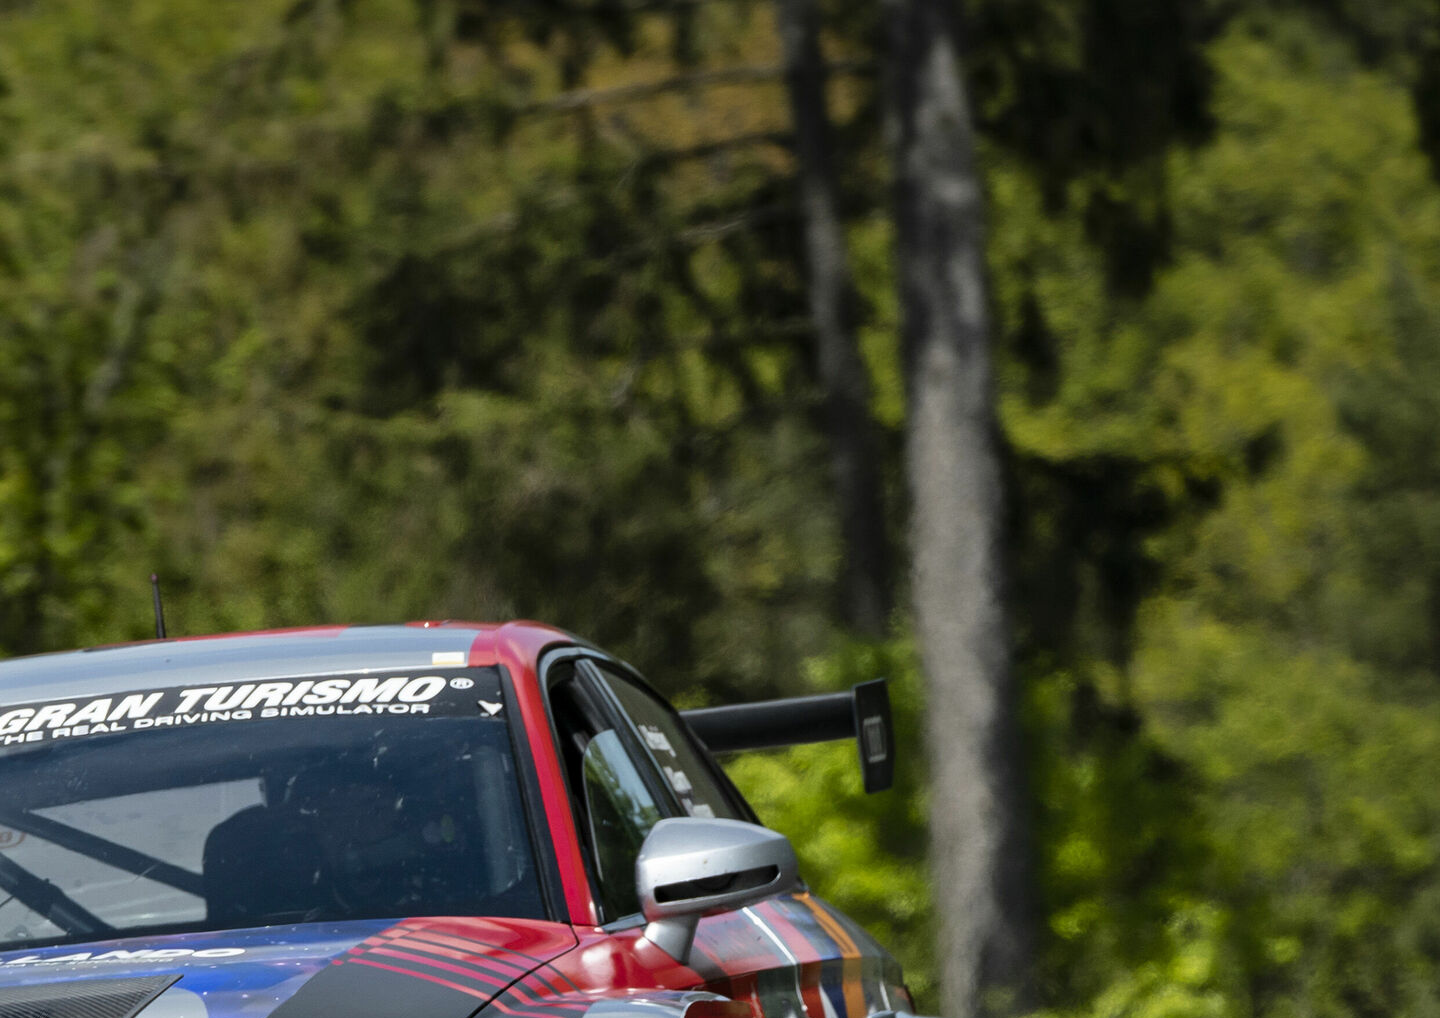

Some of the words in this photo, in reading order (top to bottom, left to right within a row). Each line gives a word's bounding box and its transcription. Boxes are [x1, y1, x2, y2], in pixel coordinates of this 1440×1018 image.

[52, 722, 127, 740] REAL
[133, 710, 253, 729] DRIVING
[259, 703, 431, 718] SIMULATOR
